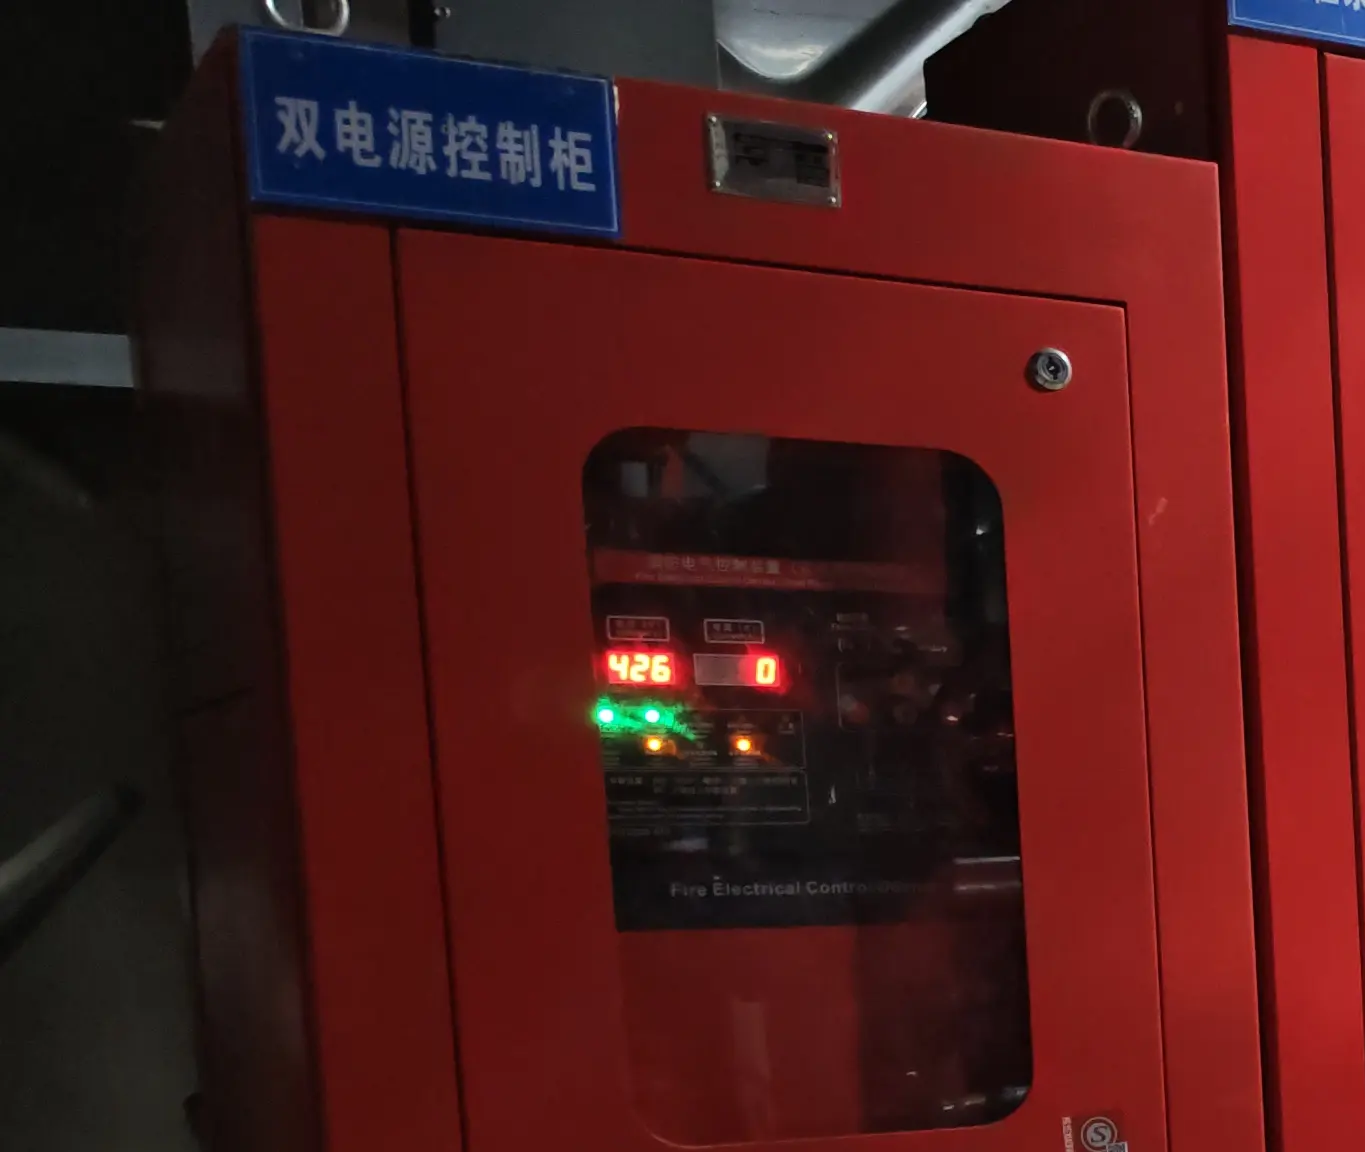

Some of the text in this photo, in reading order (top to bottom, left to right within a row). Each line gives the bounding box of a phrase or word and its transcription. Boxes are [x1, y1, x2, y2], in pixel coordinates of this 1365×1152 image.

[273, 95, 598, 193] 双电源控制柜
[608, 653, 672, 683] 426
[755, 656, 777, 684] 0
[670, 882, 707, 898] Fire
[713, 880, 800, 897] Electrical
